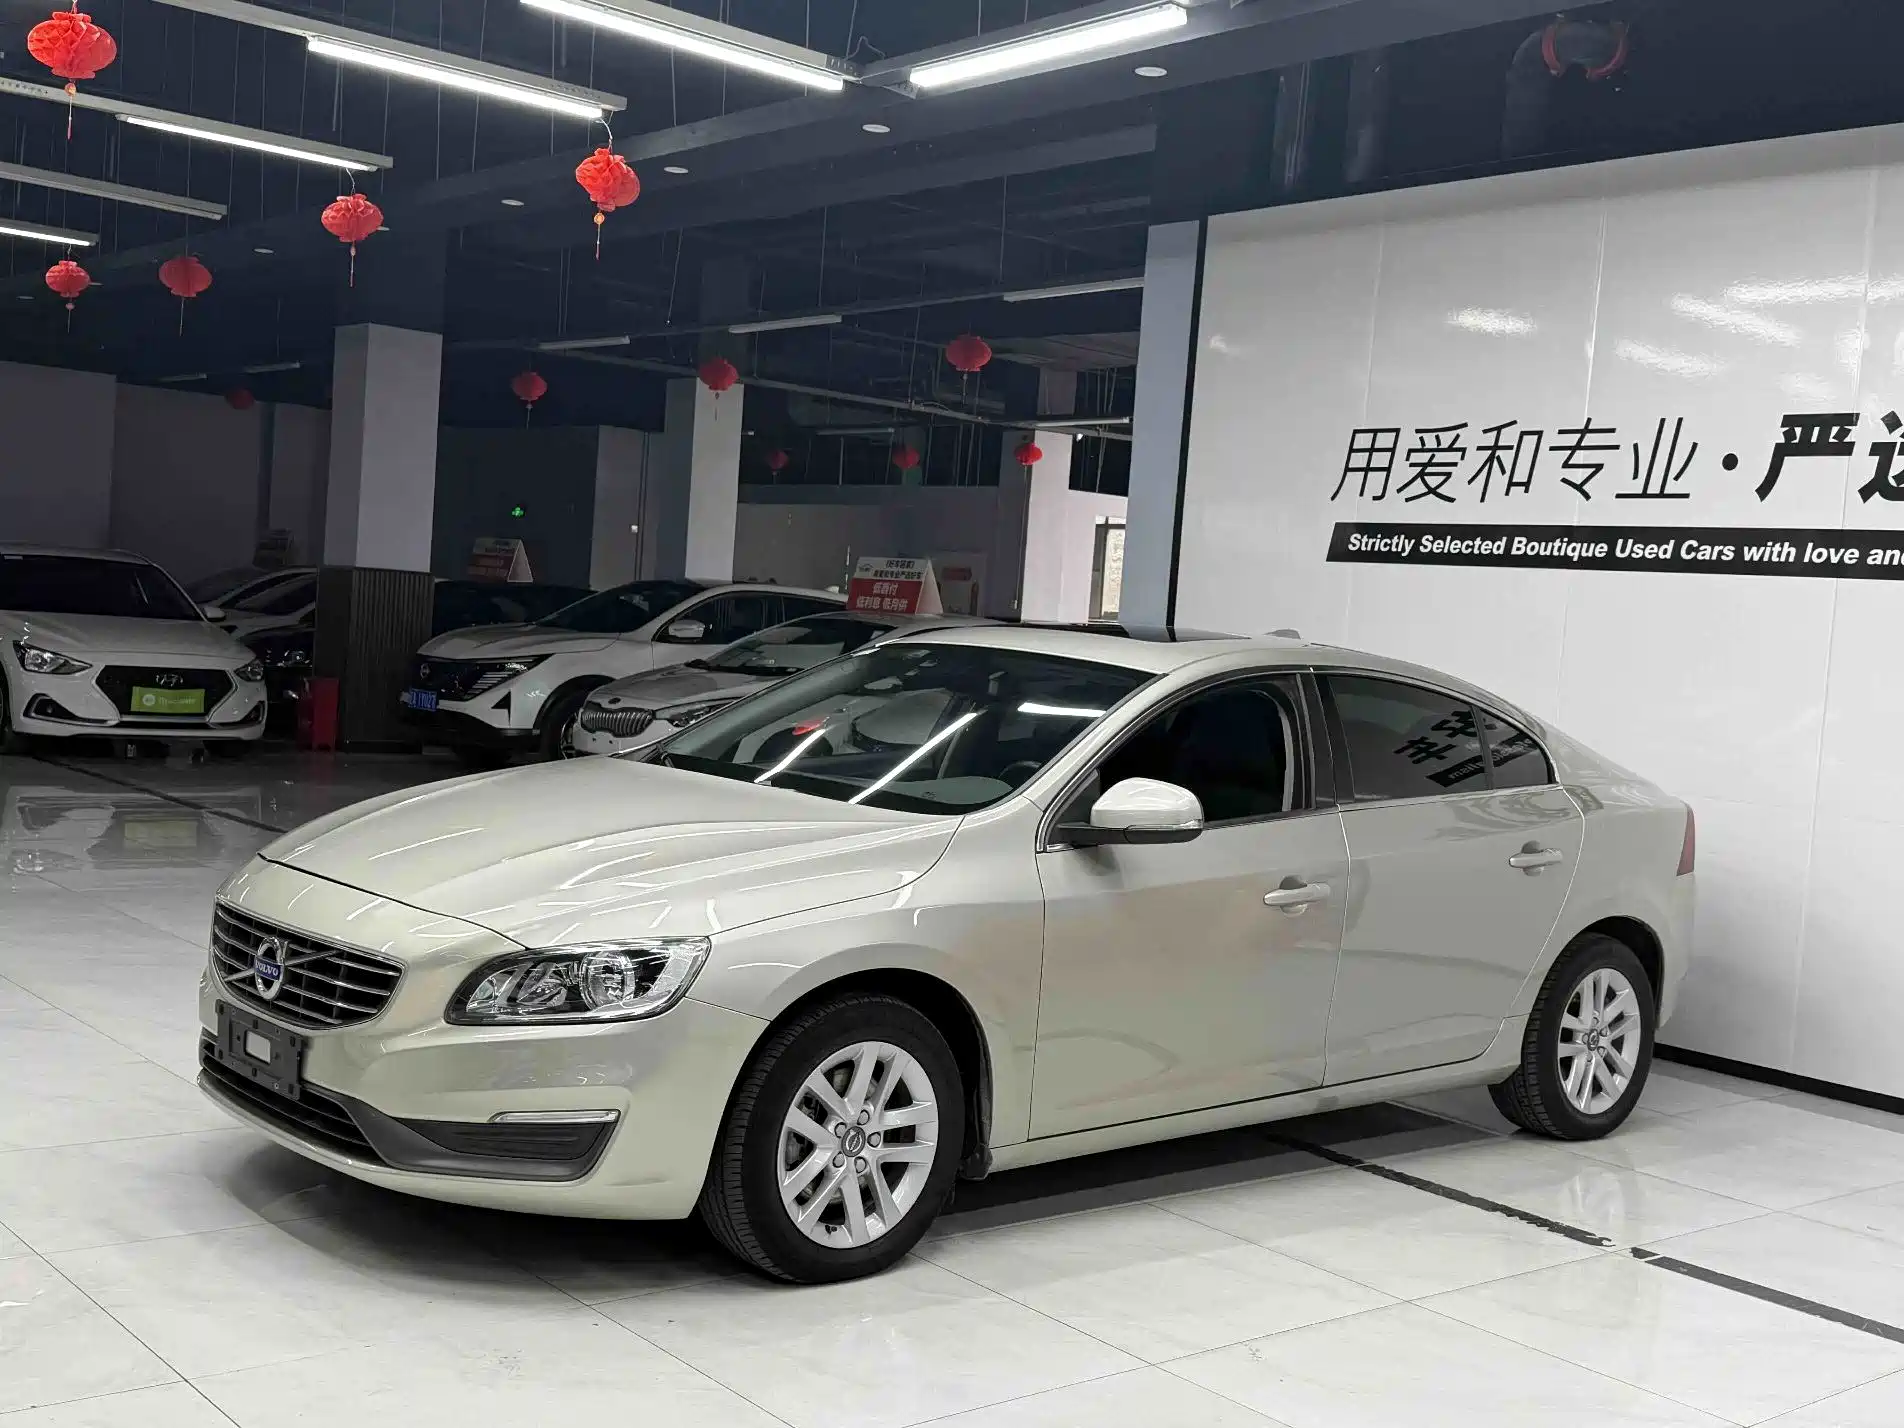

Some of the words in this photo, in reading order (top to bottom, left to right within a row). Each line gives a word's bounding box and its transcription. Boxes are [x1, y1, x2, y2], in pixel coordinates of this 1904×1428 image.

[1347, 533, 1416, 557] Strictly
[1419, 534, 1507, 555] Selected
[1510, 536, 1608, 562] Boutique
[1615, 538, 1676, 560] Used
[1680, 539, 1736, 561] Cars
[1743, 541, 1797, 563] with
[1803, 542, 1860, 565] love
[1866, 548, 1904, 566] an
[255, 961, 279, 976] VOLVO
